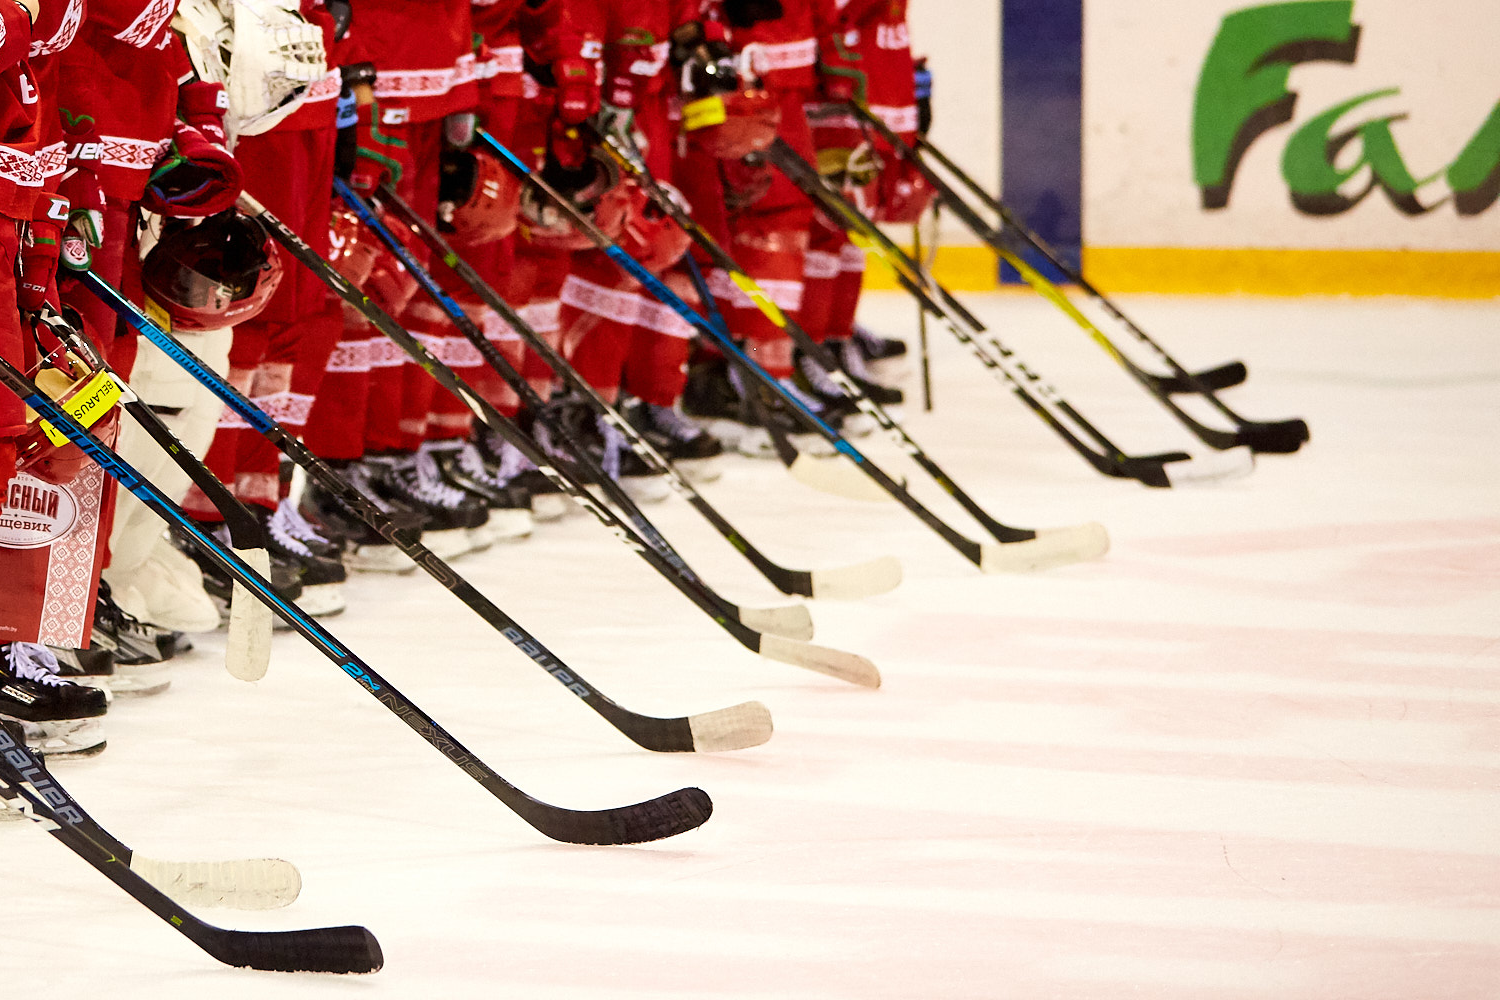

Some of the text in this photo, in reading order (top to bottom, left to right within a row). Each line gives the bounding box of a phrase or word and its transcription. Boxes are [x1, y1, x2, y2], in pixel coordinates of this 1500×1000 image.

[34, 401, 131, 489] BAUER
[3, 483, 60, 520] СНЫЙ
[501, 626, 591, 698] BAUER
[380, 692, 488, 782] NEXUS
